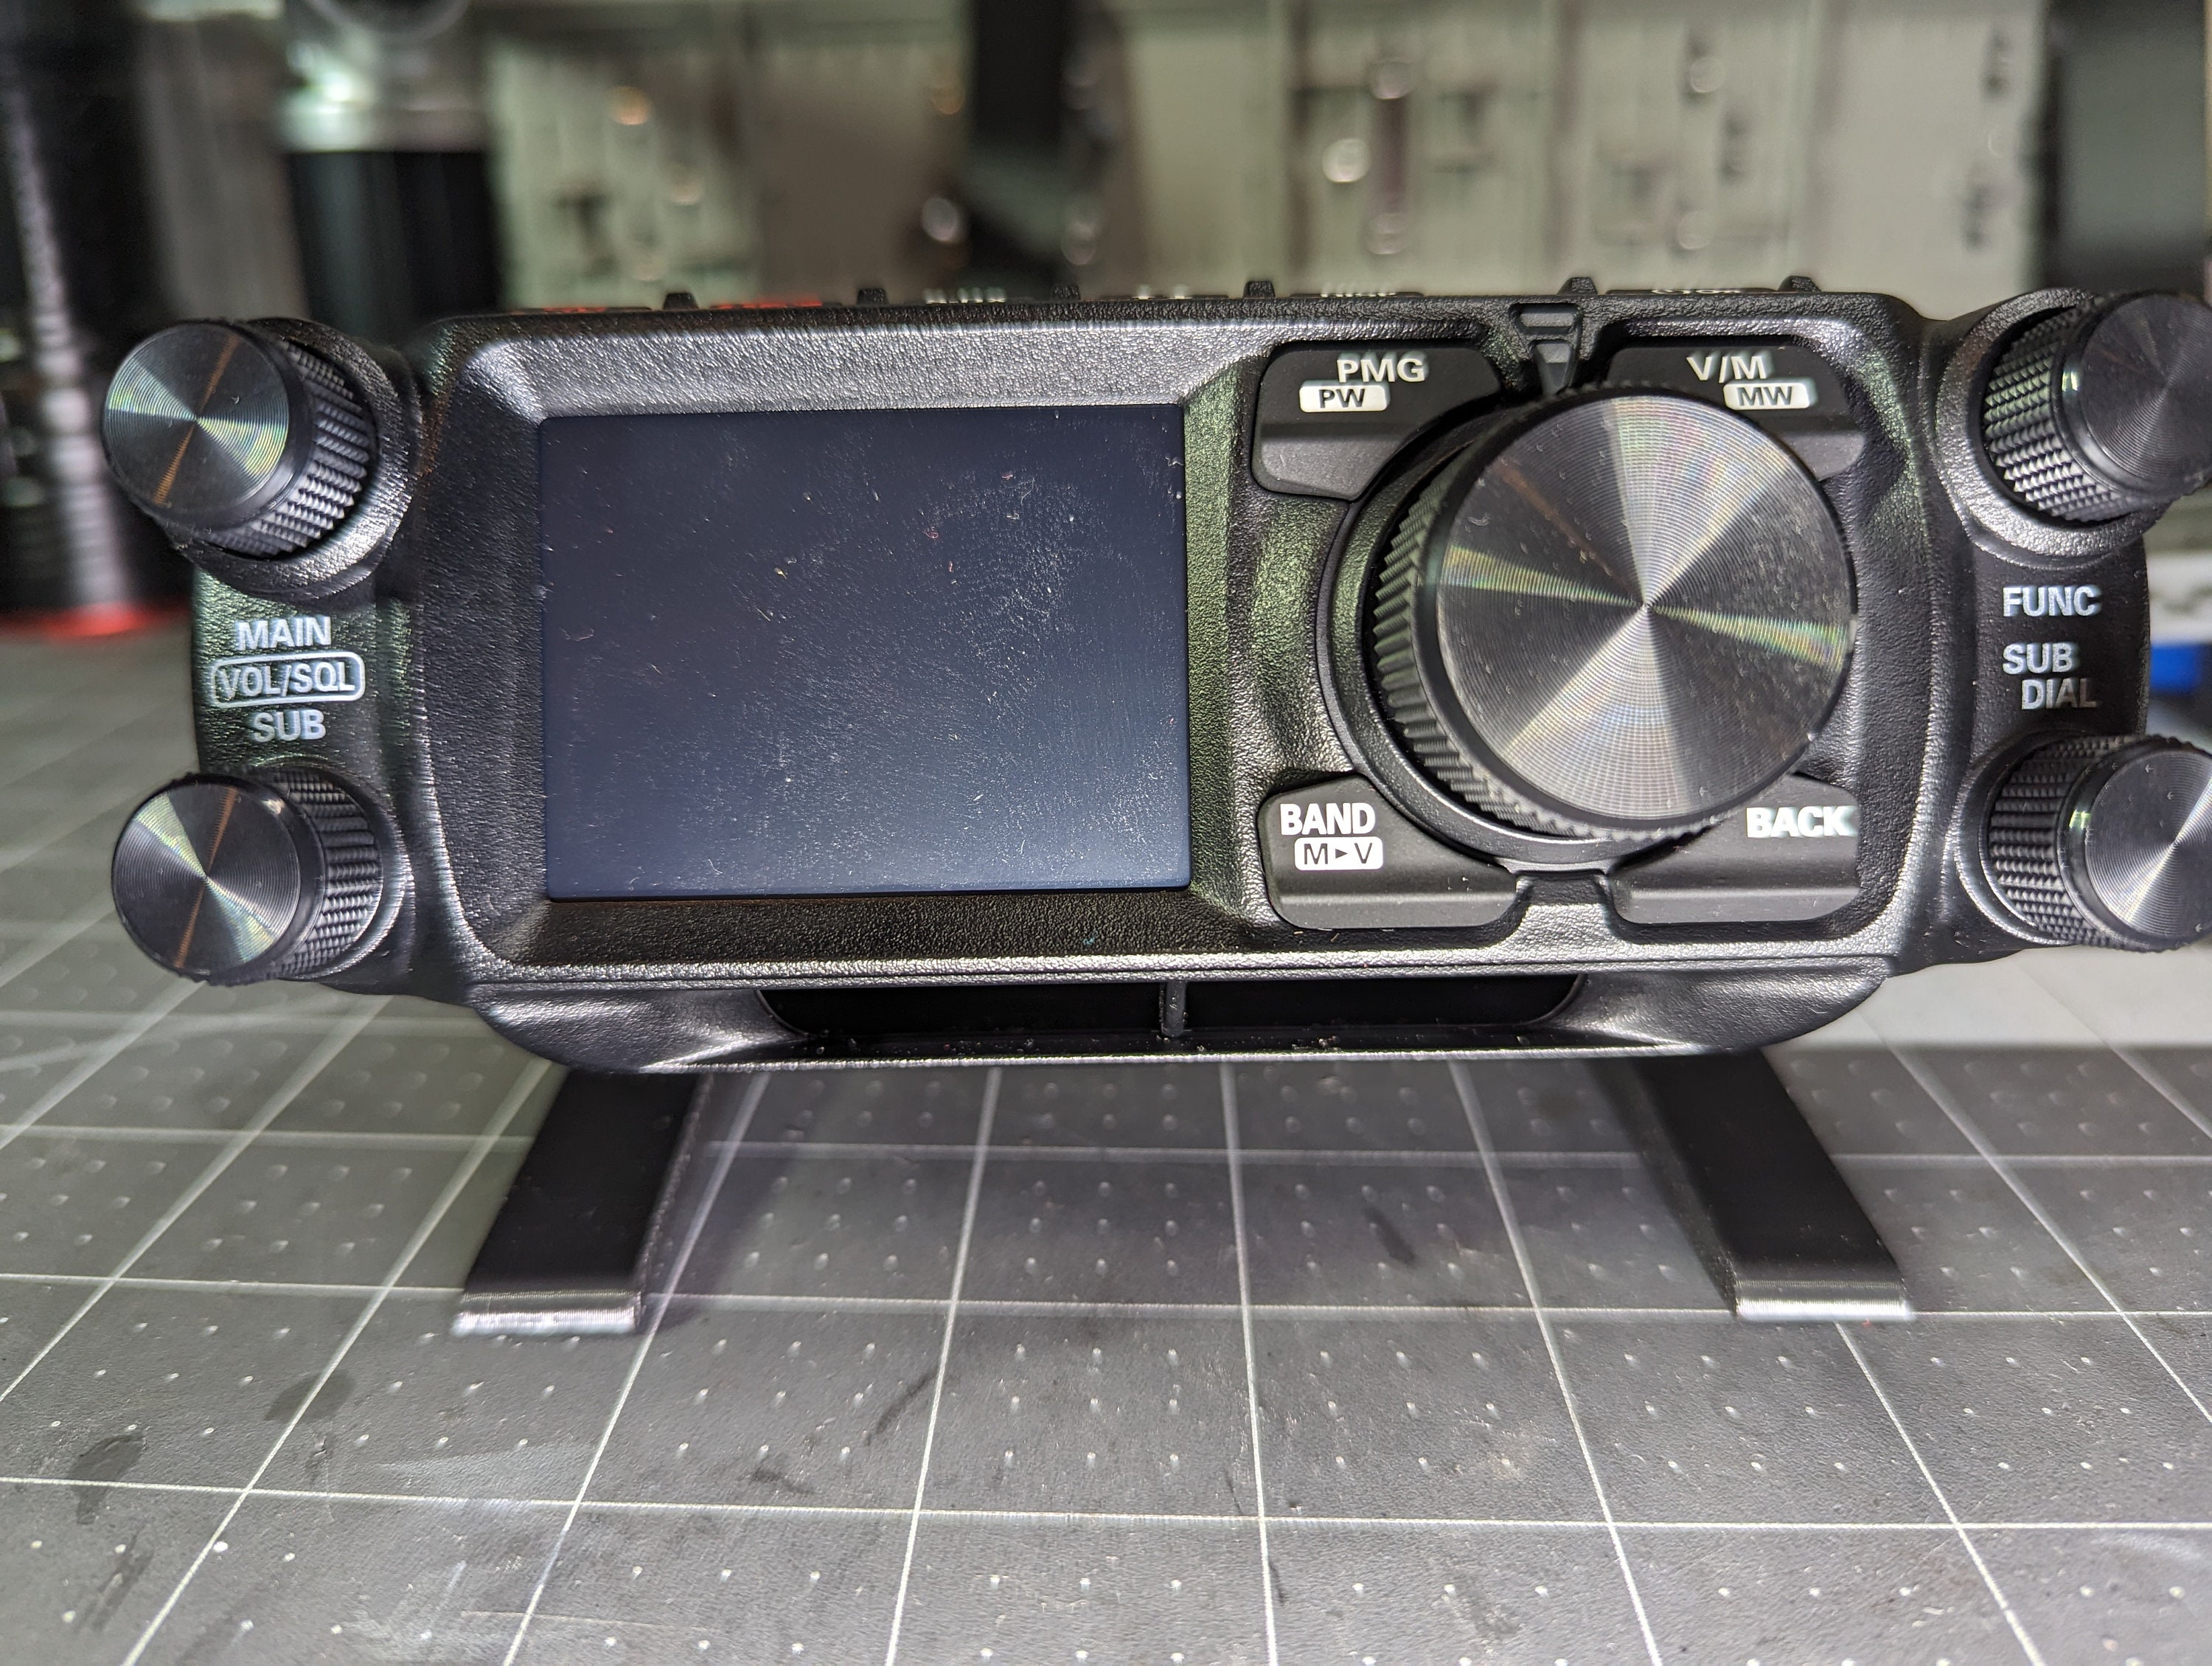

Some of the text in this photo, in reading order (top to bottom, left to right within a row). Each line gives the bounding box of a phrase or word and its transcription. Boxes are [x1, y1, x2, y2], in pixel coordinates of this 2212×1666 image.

[1336, 358, 1427, 383] PMG
[1686, 354, 1768, 384] V/M
[1318, 388, 1366, 409] PW
[1736, 386, 1793, 407] MW
[2003, 585, 2101, 617] FUNC
[234, 615, 332, 650] MAIN
[2003, 642, 2076, 675] SUB
[215, 661, 355, 701] VOL/SQL
[2021, 678, 2097, 709] DIAL
[248, 709, 327, 743] SUB
[1279, 802, 1376, 836] BAND
[1746, 805, 1858, 839] BACK
